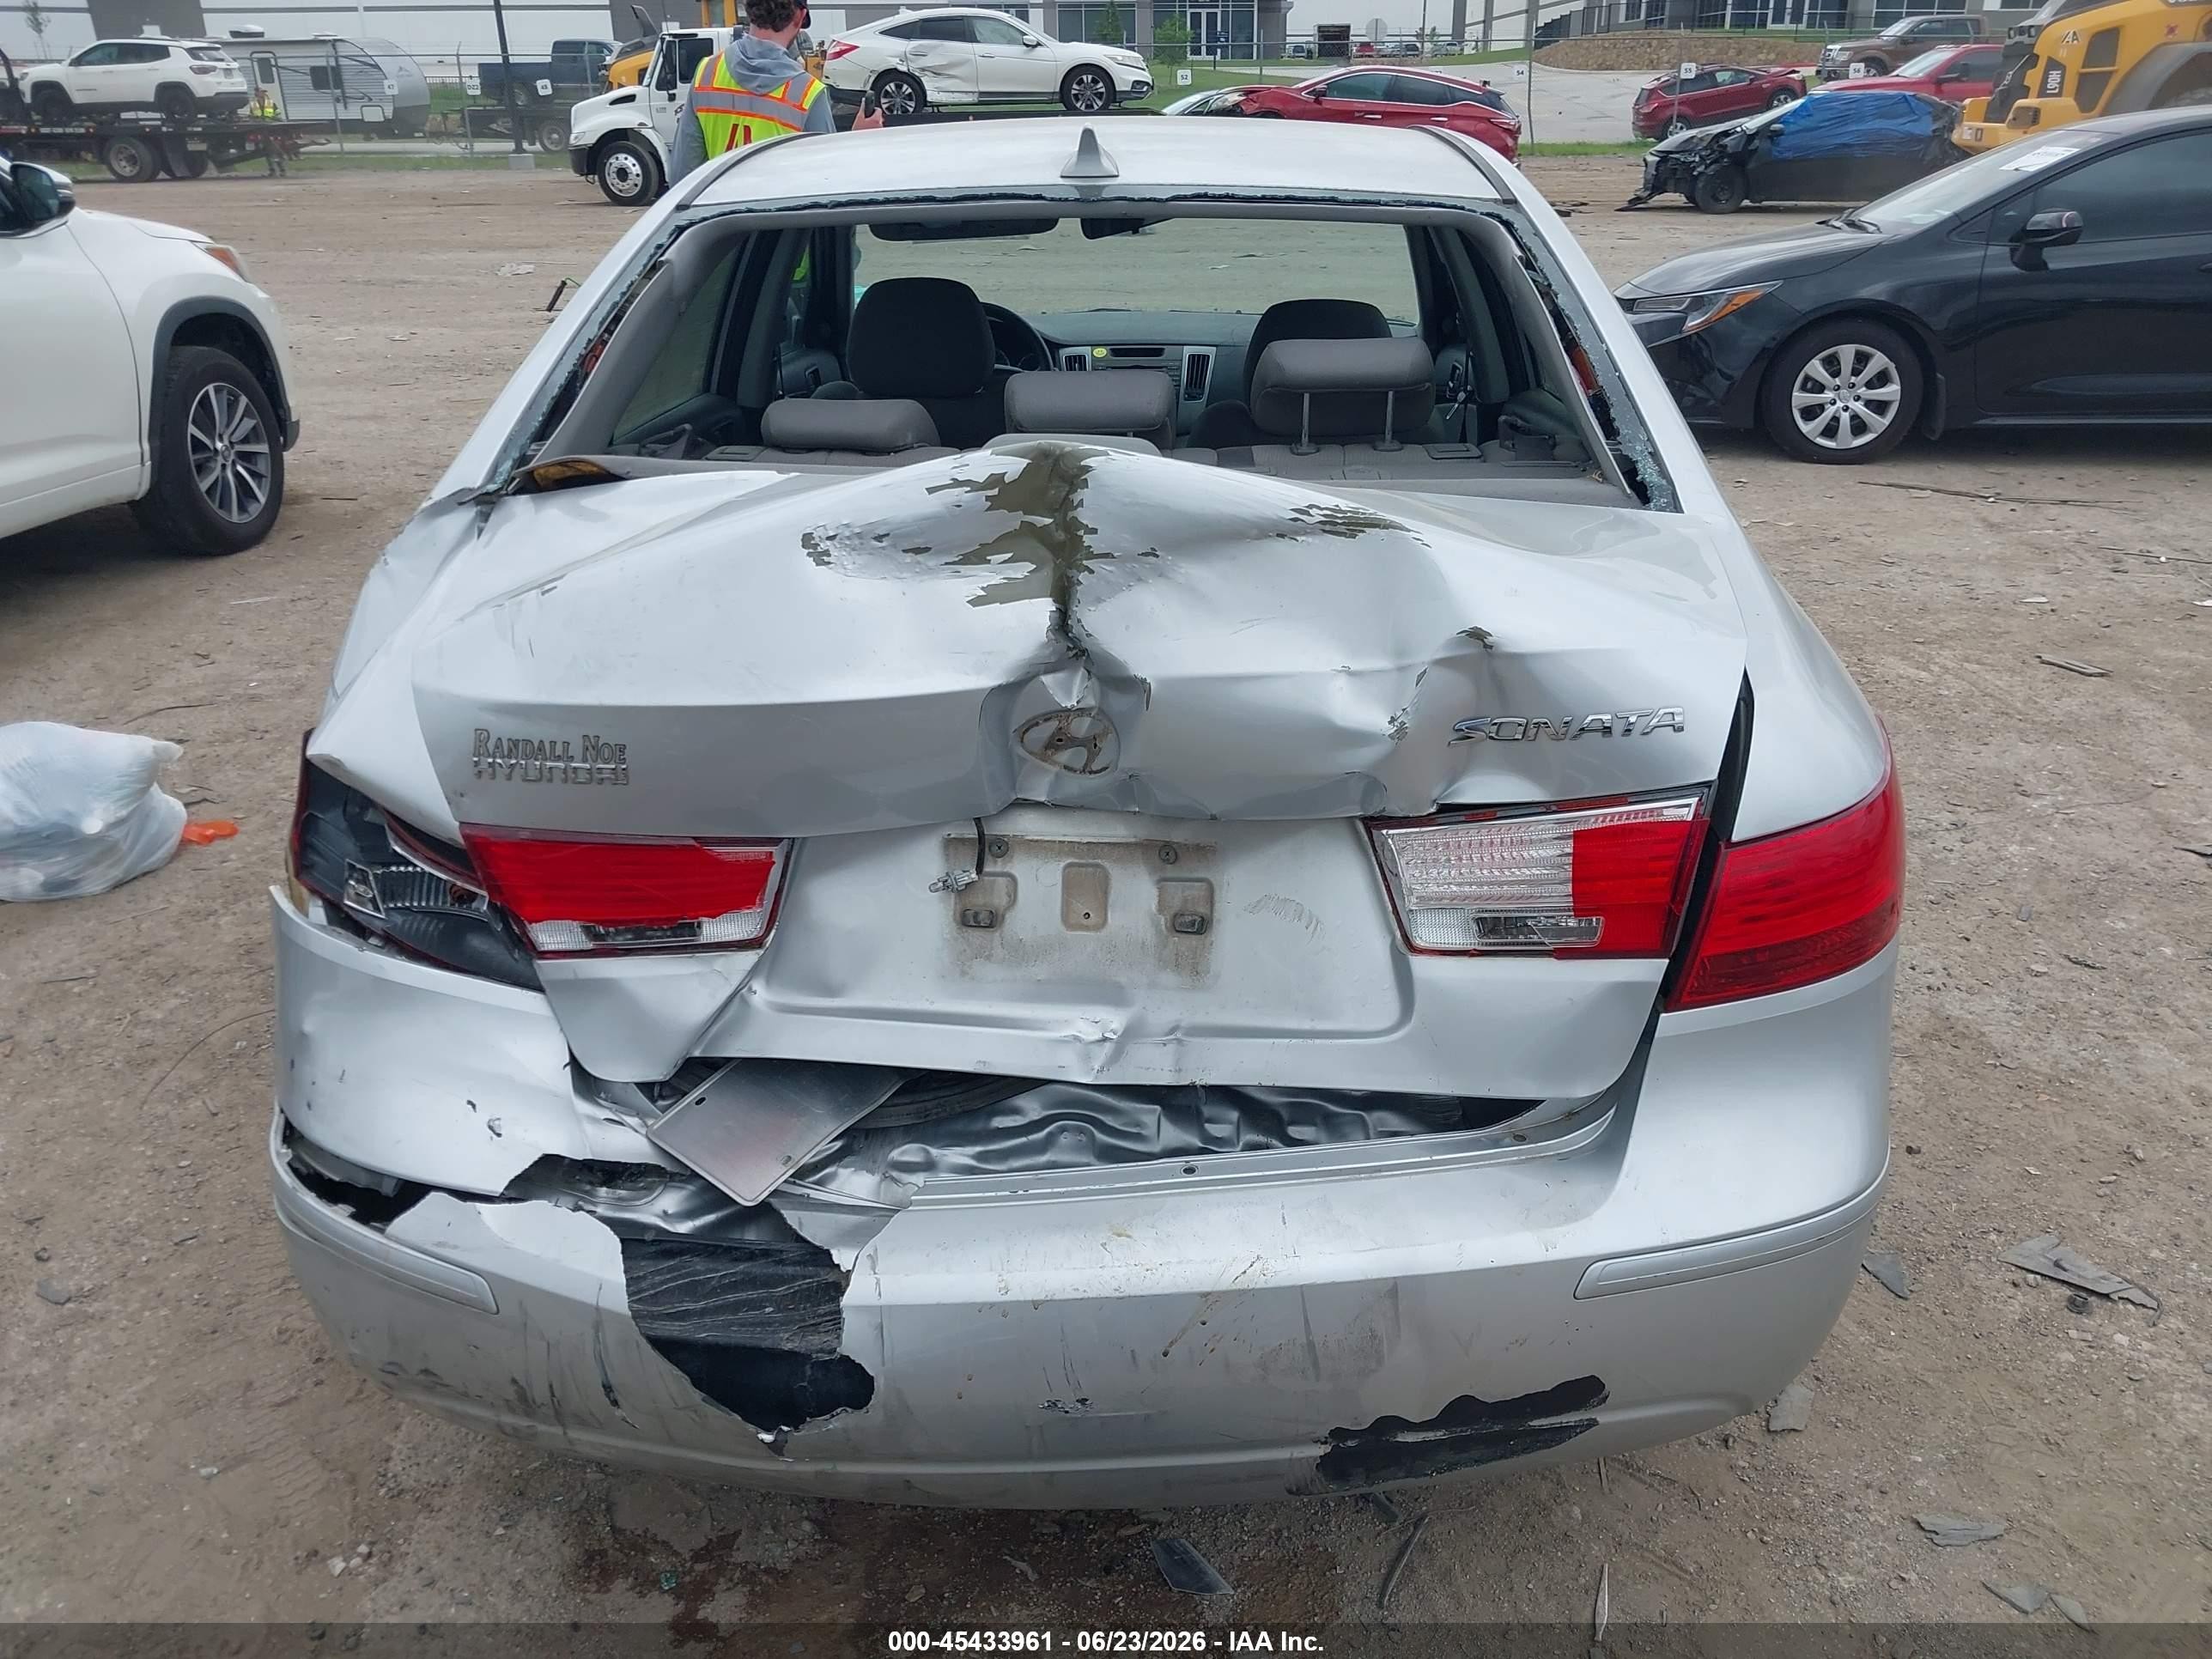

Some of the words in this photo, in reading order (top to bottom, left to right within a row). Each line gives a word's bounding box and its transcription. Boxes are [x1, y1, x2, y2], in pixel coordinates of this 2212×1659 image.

[2046, 70, 2062, 94] L90H
[1448, 707, 1685, 747] SONATA
[473, 757, 629, 786] HYUNDAI
